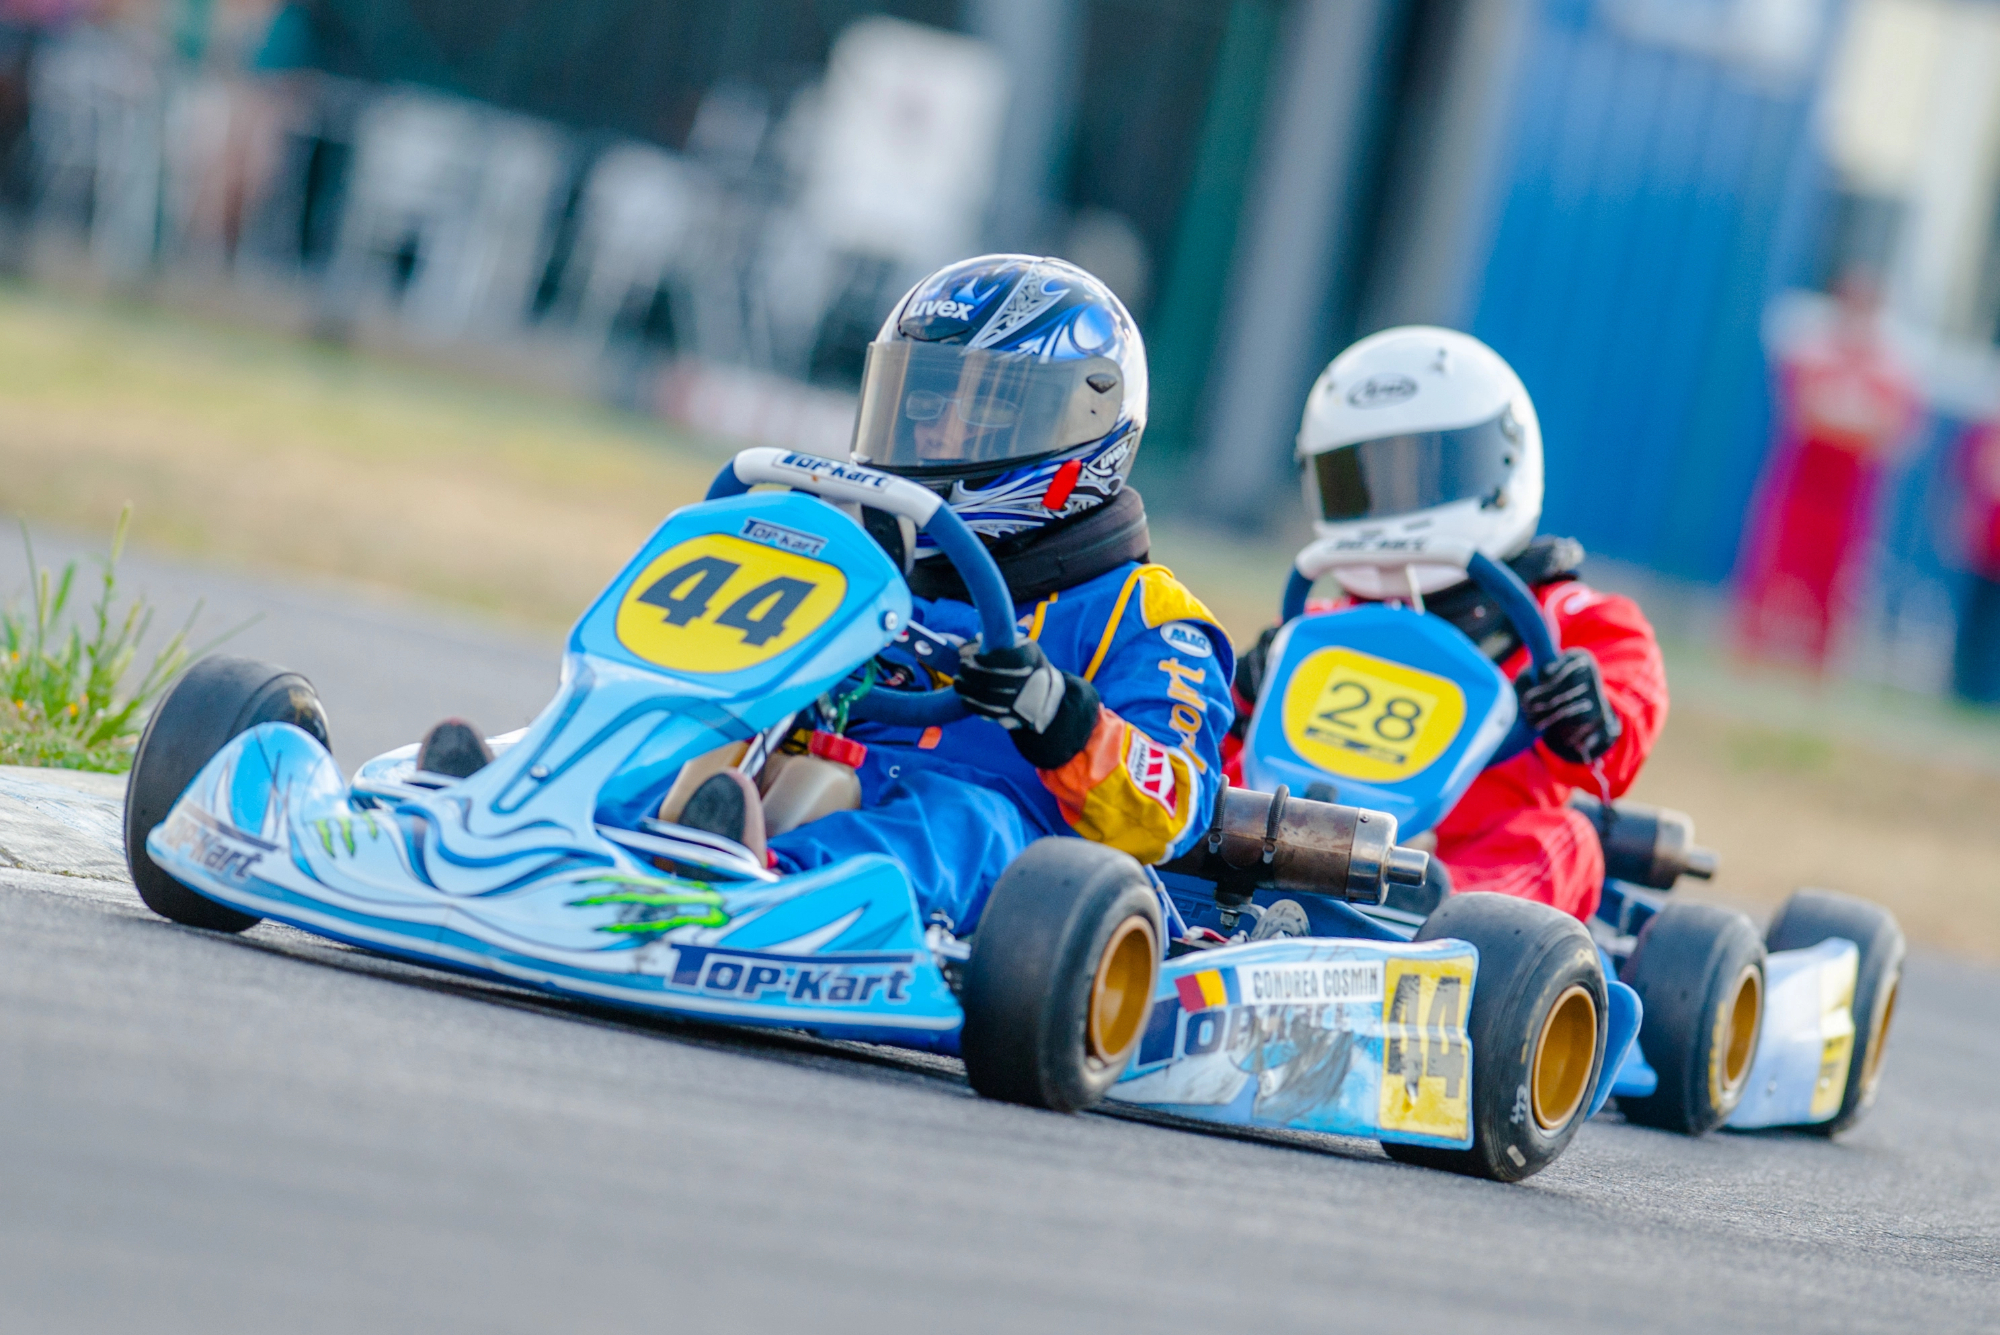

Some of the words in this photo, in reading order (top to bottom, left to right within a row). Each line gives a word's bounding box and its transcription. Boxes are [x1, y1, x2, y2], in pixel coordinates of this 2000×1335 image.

[909, 298, 974, 321] uvex
[636, 555, 819, 647] 44
[1316, 679, 1422, 744] 28
[1323, 967, 1378, 997] COSMIN
[1388, 974, 1464, 1100] 44
